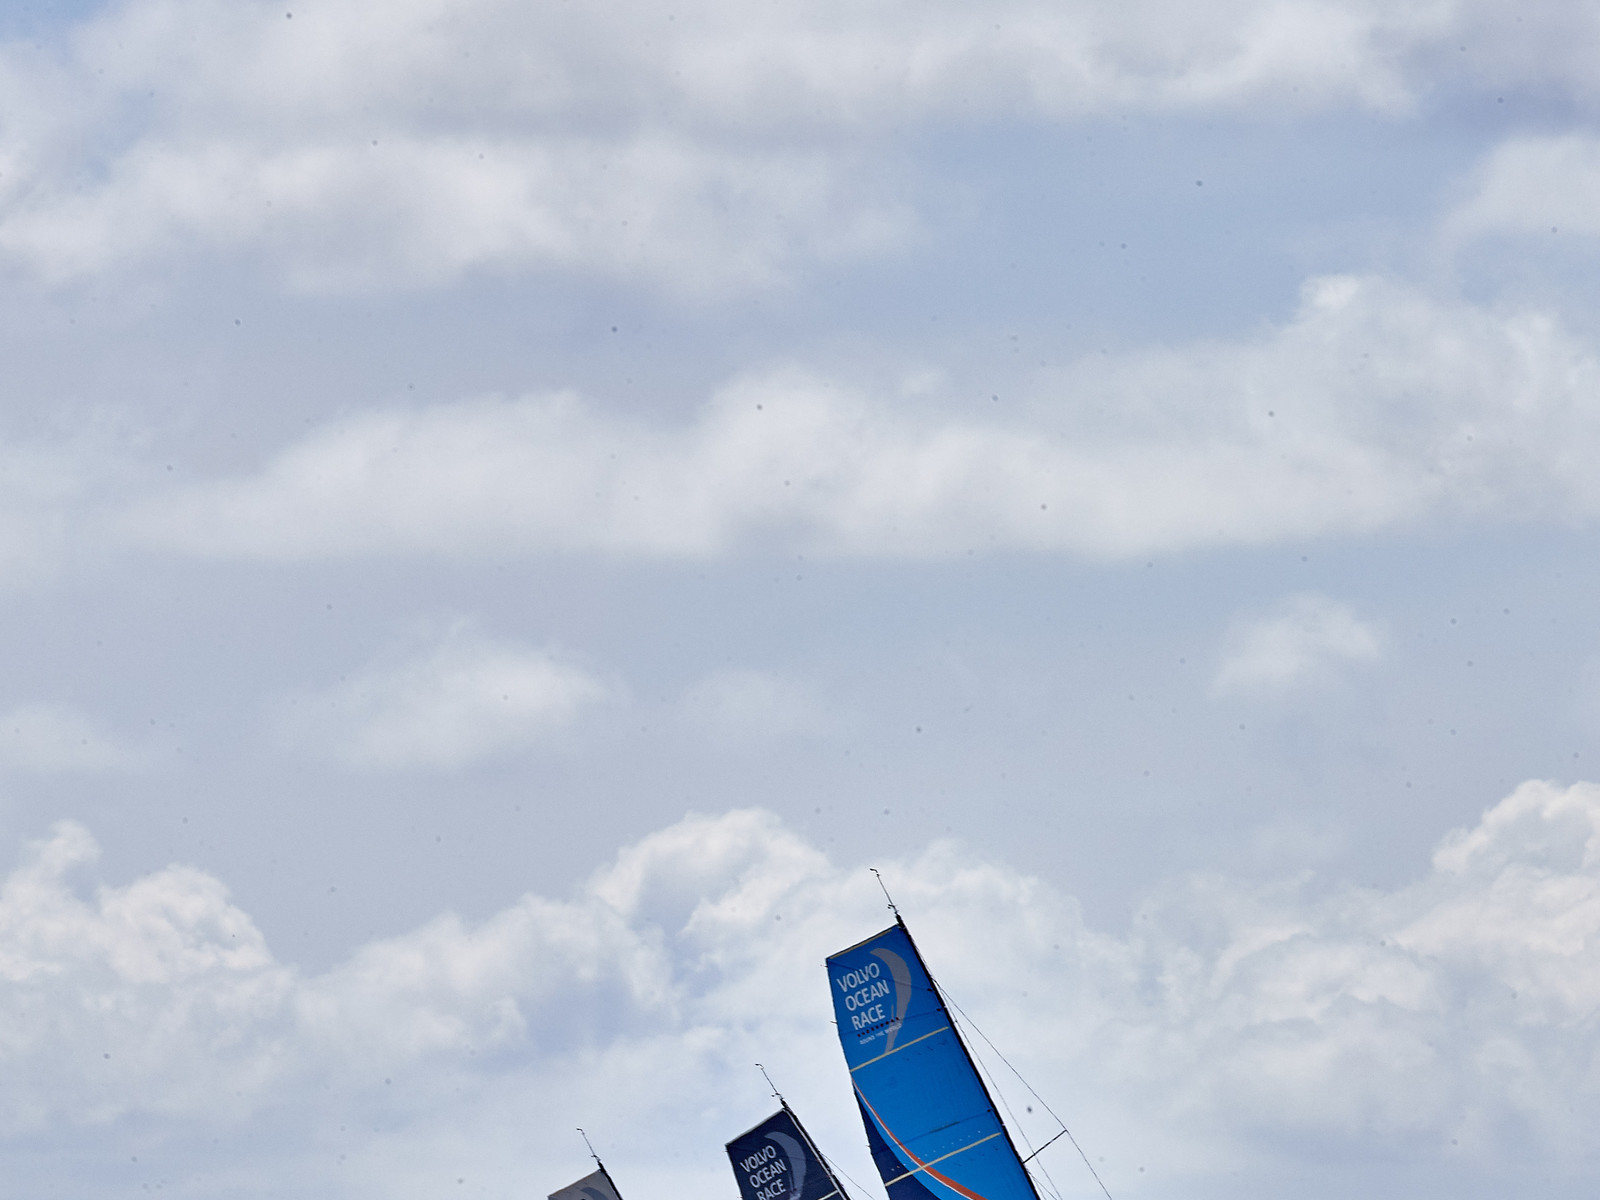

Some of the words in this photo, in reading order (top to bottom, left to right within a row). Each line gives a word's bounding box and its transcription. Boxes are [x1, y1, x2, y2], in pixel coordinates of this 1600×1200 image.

[836, 963, 880, 992] VOLVO
[845, 979, 890, 1011] OCEAN
[851, 1004, 885, 1030] RACE
[740, 1145, 776, 1173] VOLVO
[749, 1159, 787, 1188] OCEAN
